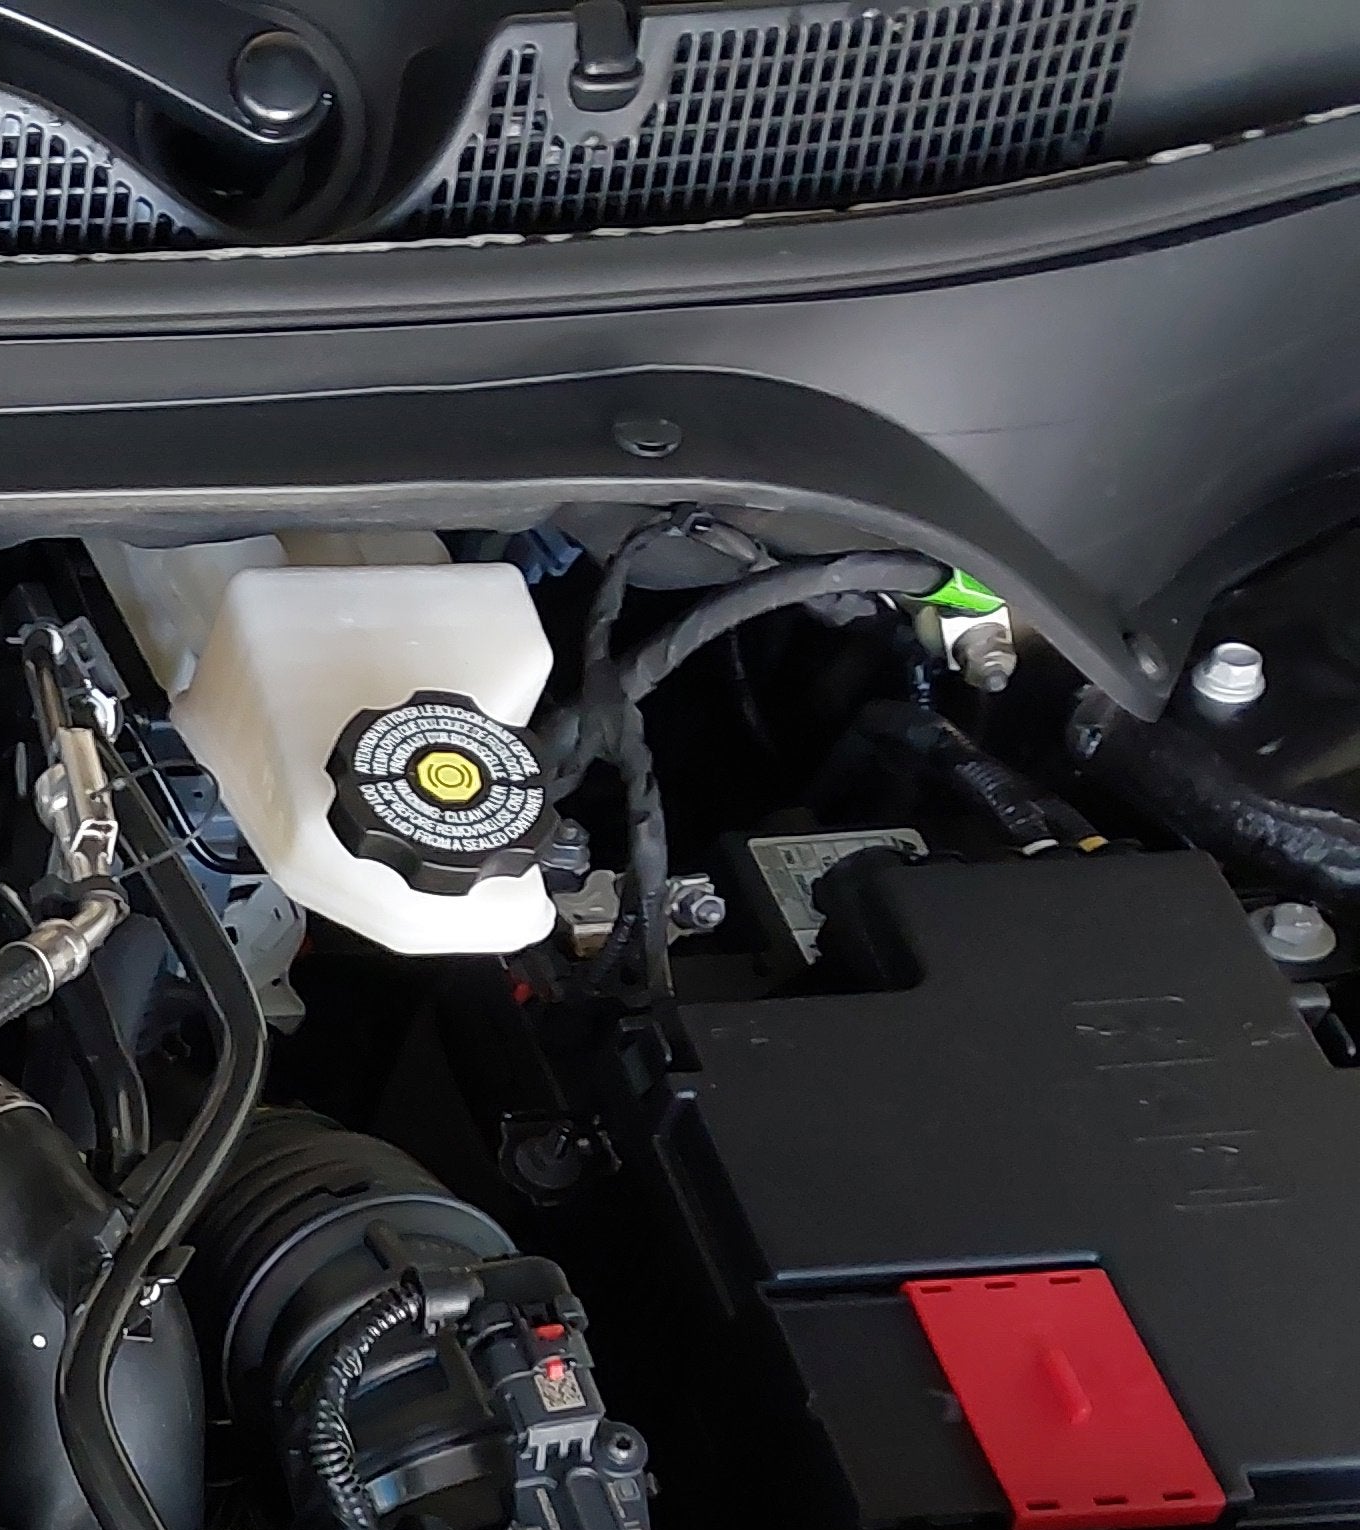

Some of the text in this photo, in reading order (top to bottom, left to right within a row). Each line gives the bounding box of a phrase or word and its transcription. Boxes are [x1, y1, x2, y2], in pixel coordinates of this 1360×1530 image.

[359, 783, 383, 806] DOT
[375, 781, 399, 804] CAP
[490, 807, 516, 827] USE
[443, 807, 486, 822] CLEAN
[479, 784, 508, 815] FILLER
[371, 802, 388, 814] 4
[377, 808, 416, 838] FLUID
[411, 828, 451, 850] FROM
[452, 838, 462, 850] A
[462, 830, 510, 850] SEALED
